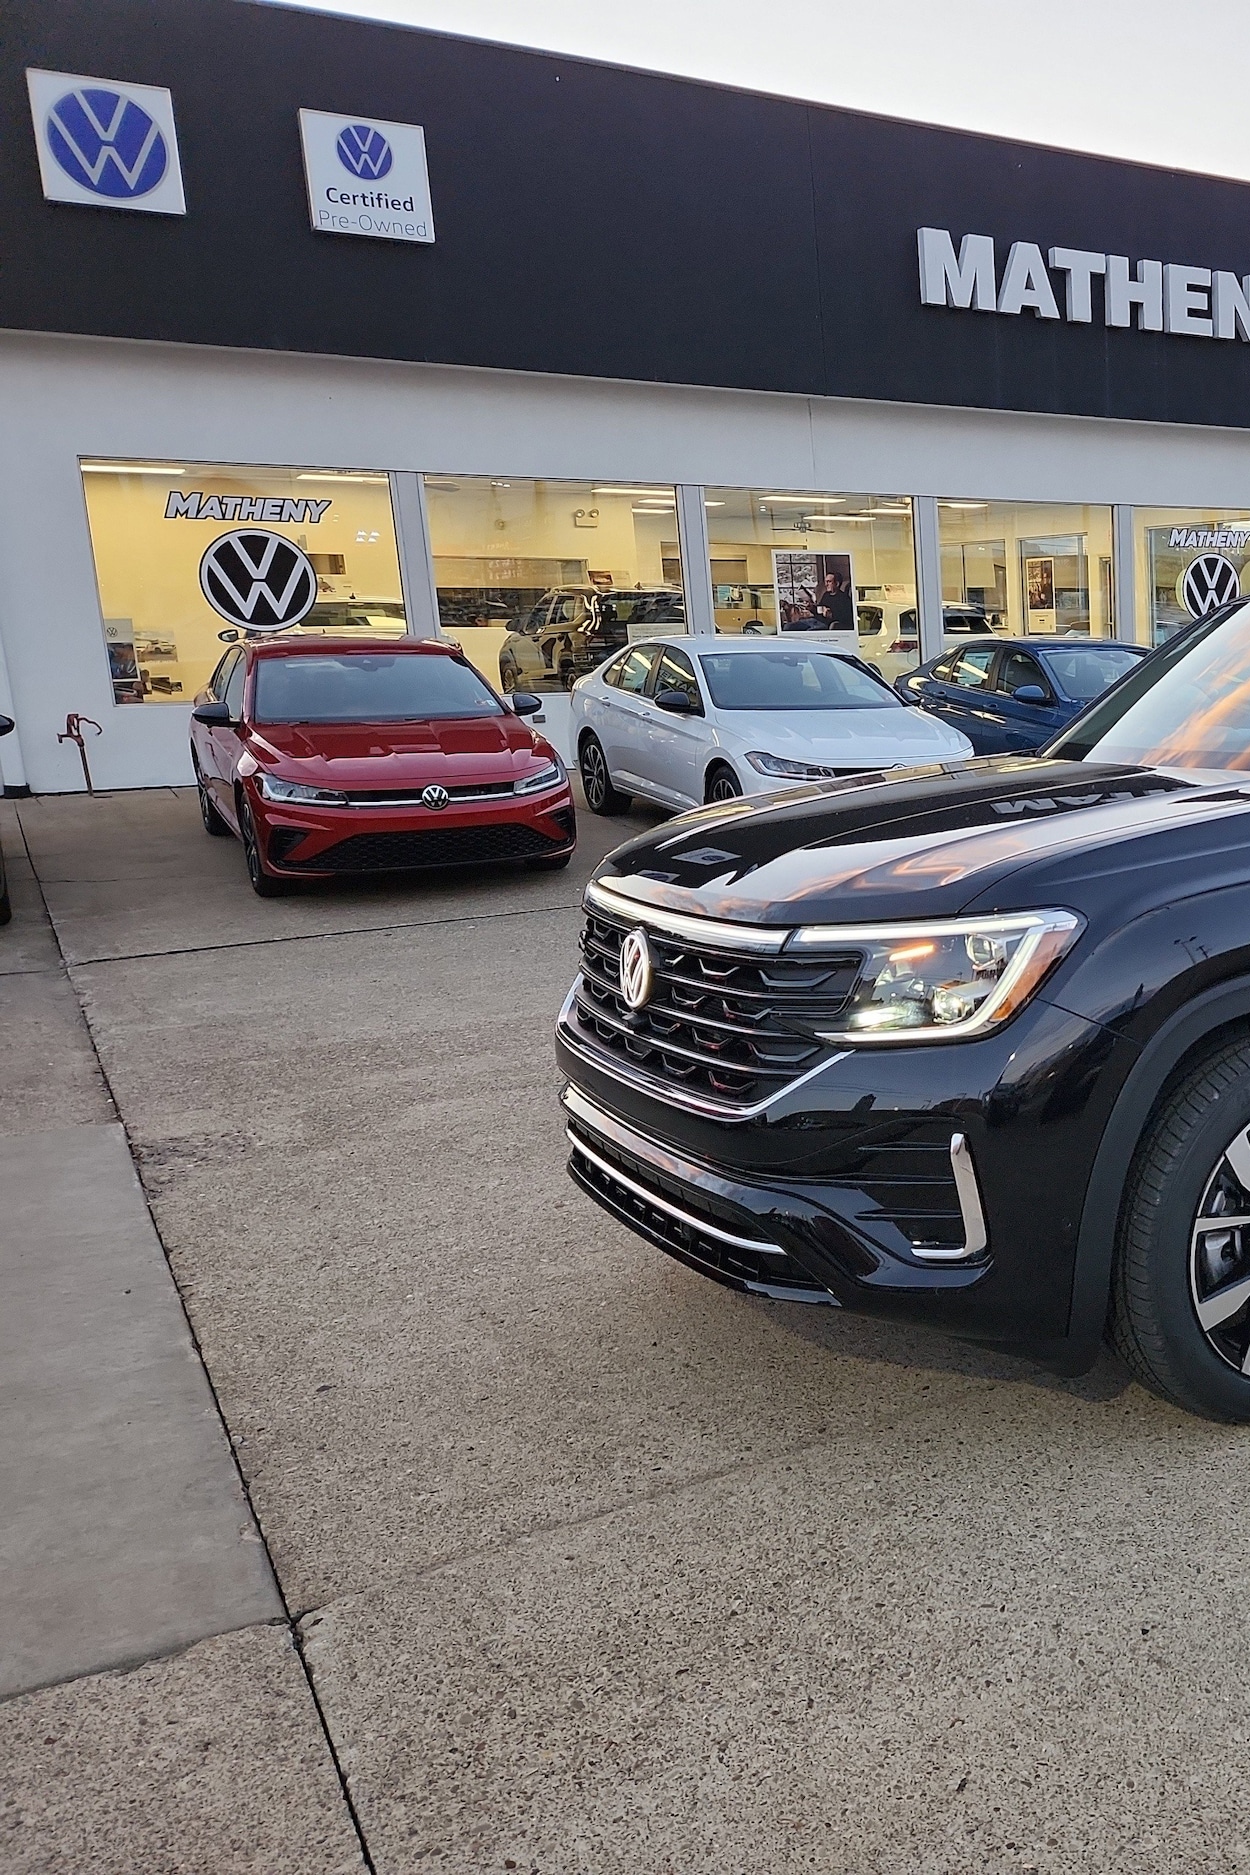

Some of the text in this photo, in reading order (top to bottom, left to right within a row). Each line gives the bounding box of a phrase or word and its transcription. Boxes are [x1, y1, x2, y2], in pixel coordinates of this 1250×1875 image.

[325, 187, 414, 213] Certified
[318, 210, 428, 237] Pre-Owned
[164, 490, 332, 524] MATHENY
